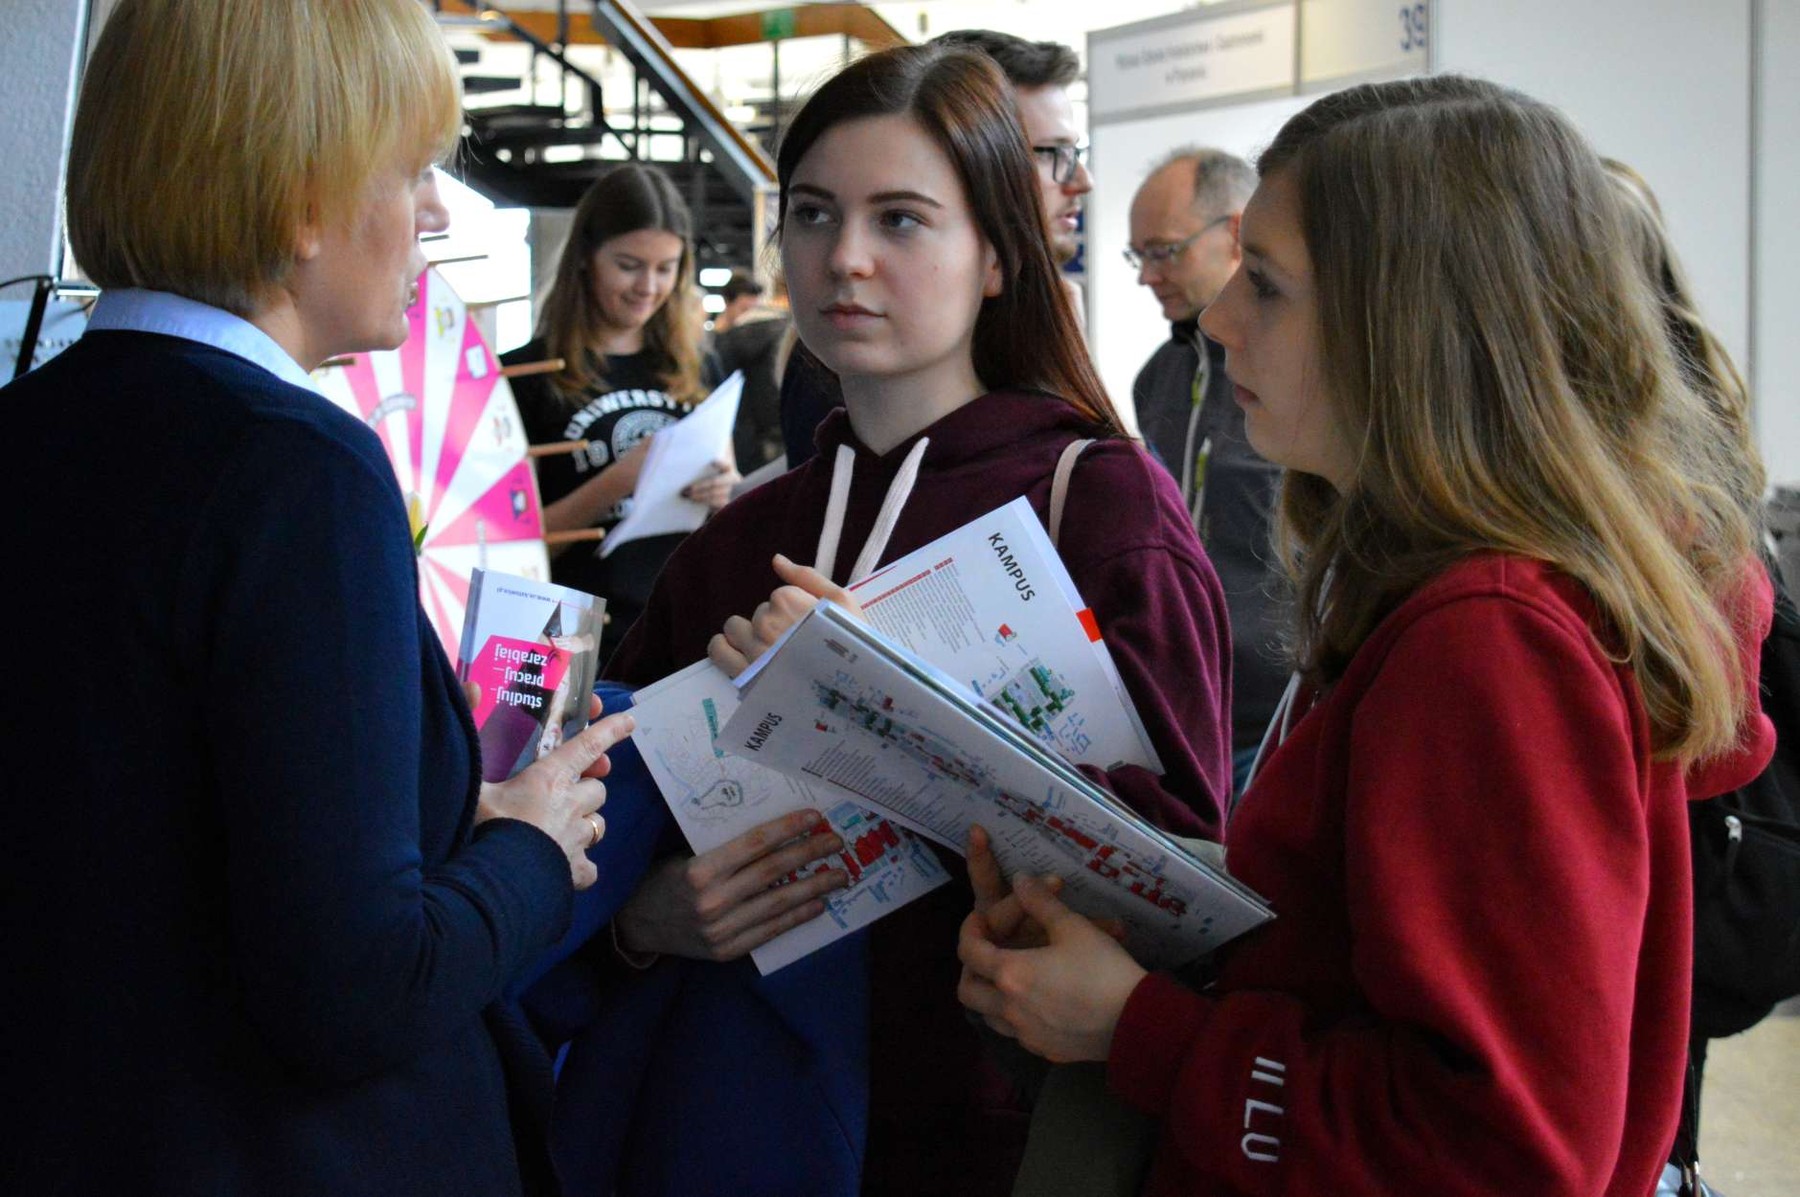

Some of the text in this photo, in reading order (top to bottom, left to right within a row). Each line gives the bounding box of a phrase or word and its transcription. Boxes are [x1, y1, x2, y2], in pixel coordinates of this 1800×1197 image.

[563, 389, 694, 441] UNIWERSY
[987, 531, 1036, 602] KAMPUS
[494, 643, 548, 666] zarabiaj
[504, 666, 545, 687] pracuj
[495, 686, 543, 708] studiuj
[745, 712, 783, 752] KAMPUS
